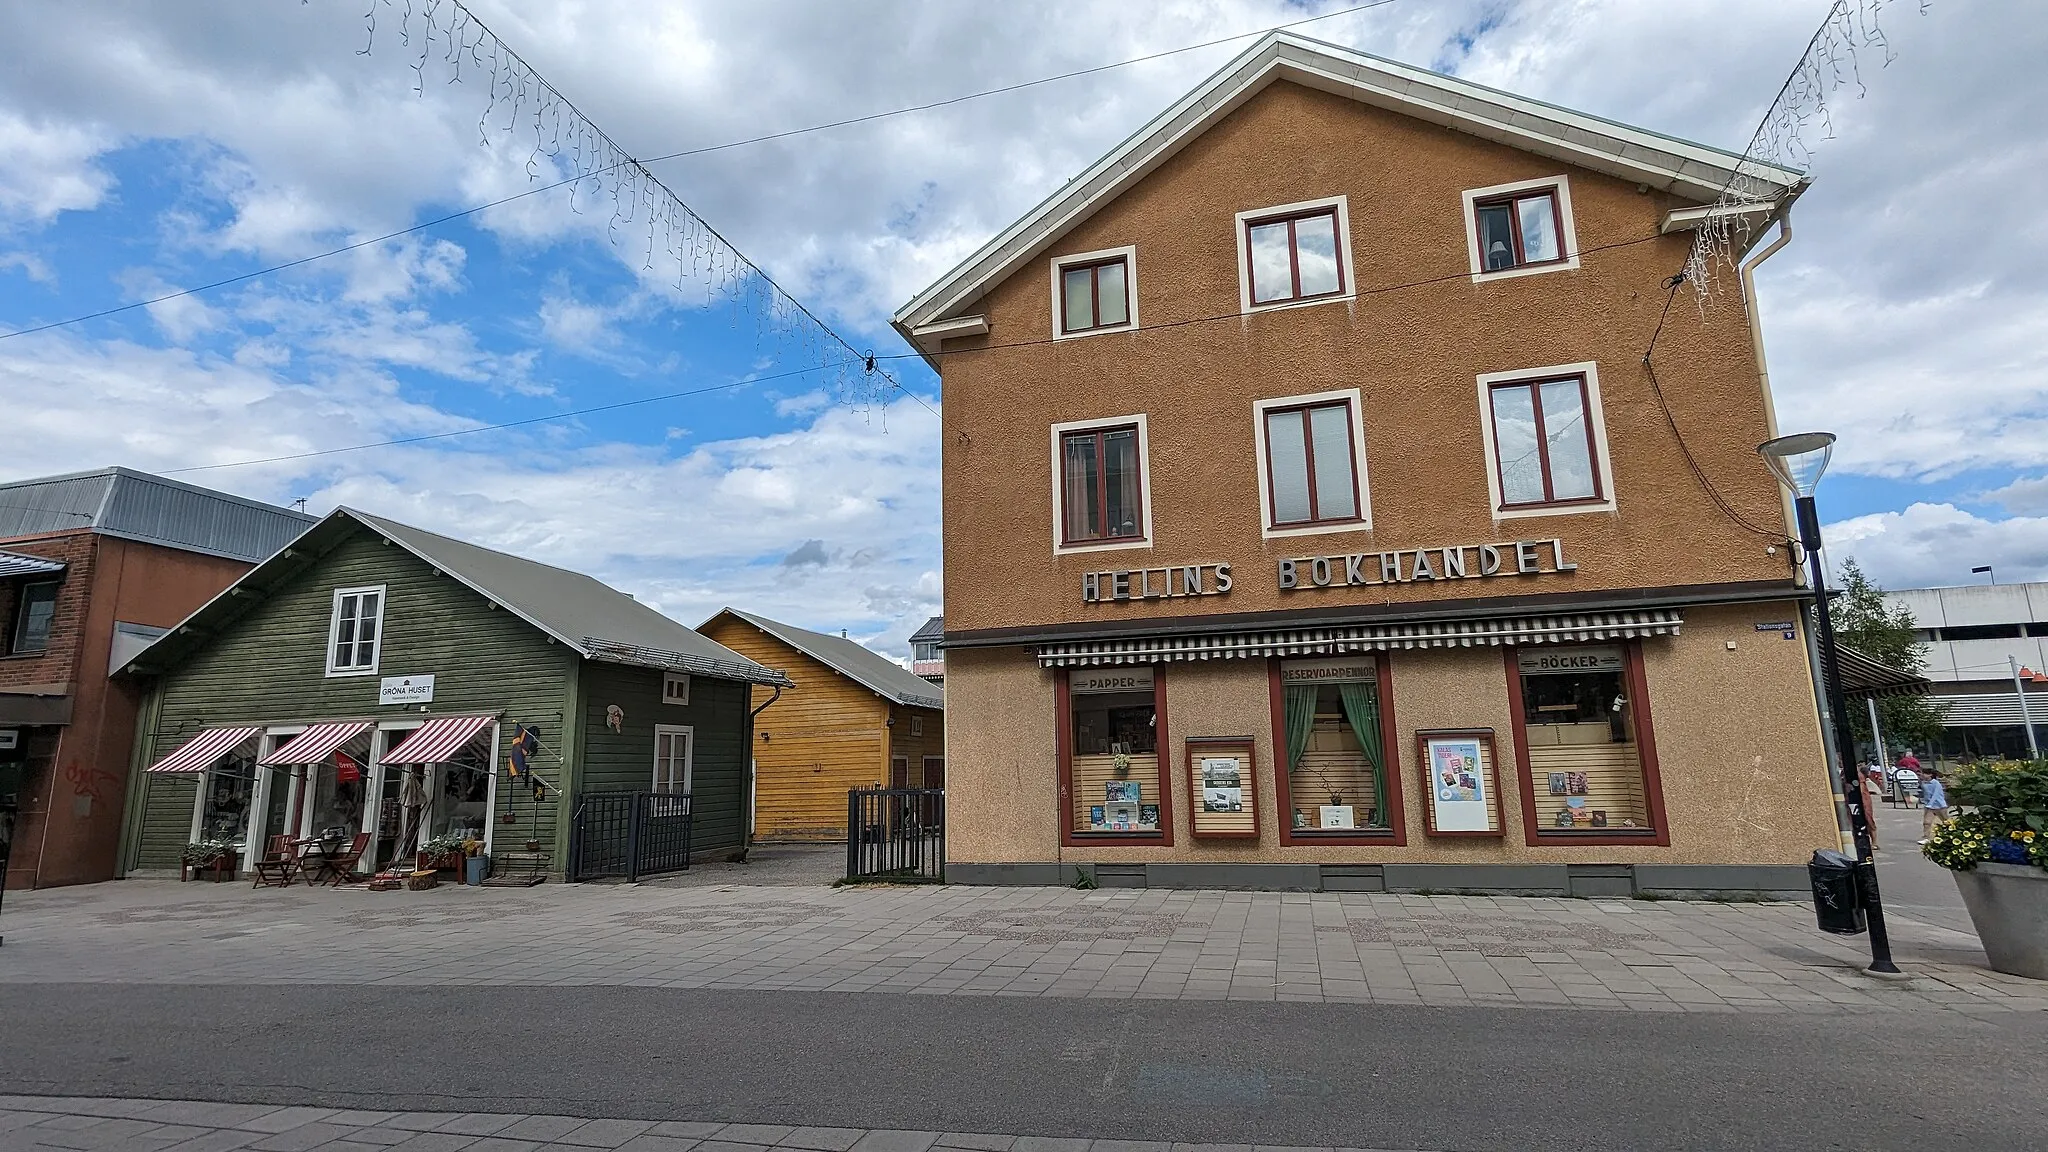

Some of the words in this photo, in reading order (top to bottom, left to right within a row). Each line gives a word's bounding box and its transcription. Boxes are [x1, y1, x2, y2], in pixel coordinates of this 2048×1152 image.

[1082, 562, 1233, 601] HELINS
[1278, 538, 1578, 589] BOKHANDEL
[1540, 655, 1598, 668] BÖCKER
[1282, 666, 1375, 680] RESERVOARPENNOR
[1089, 677, 1135, 689] PAPPER
[382, 687, 406, 695] GRÖNA
[408, 685, 431, 694] HUSET
